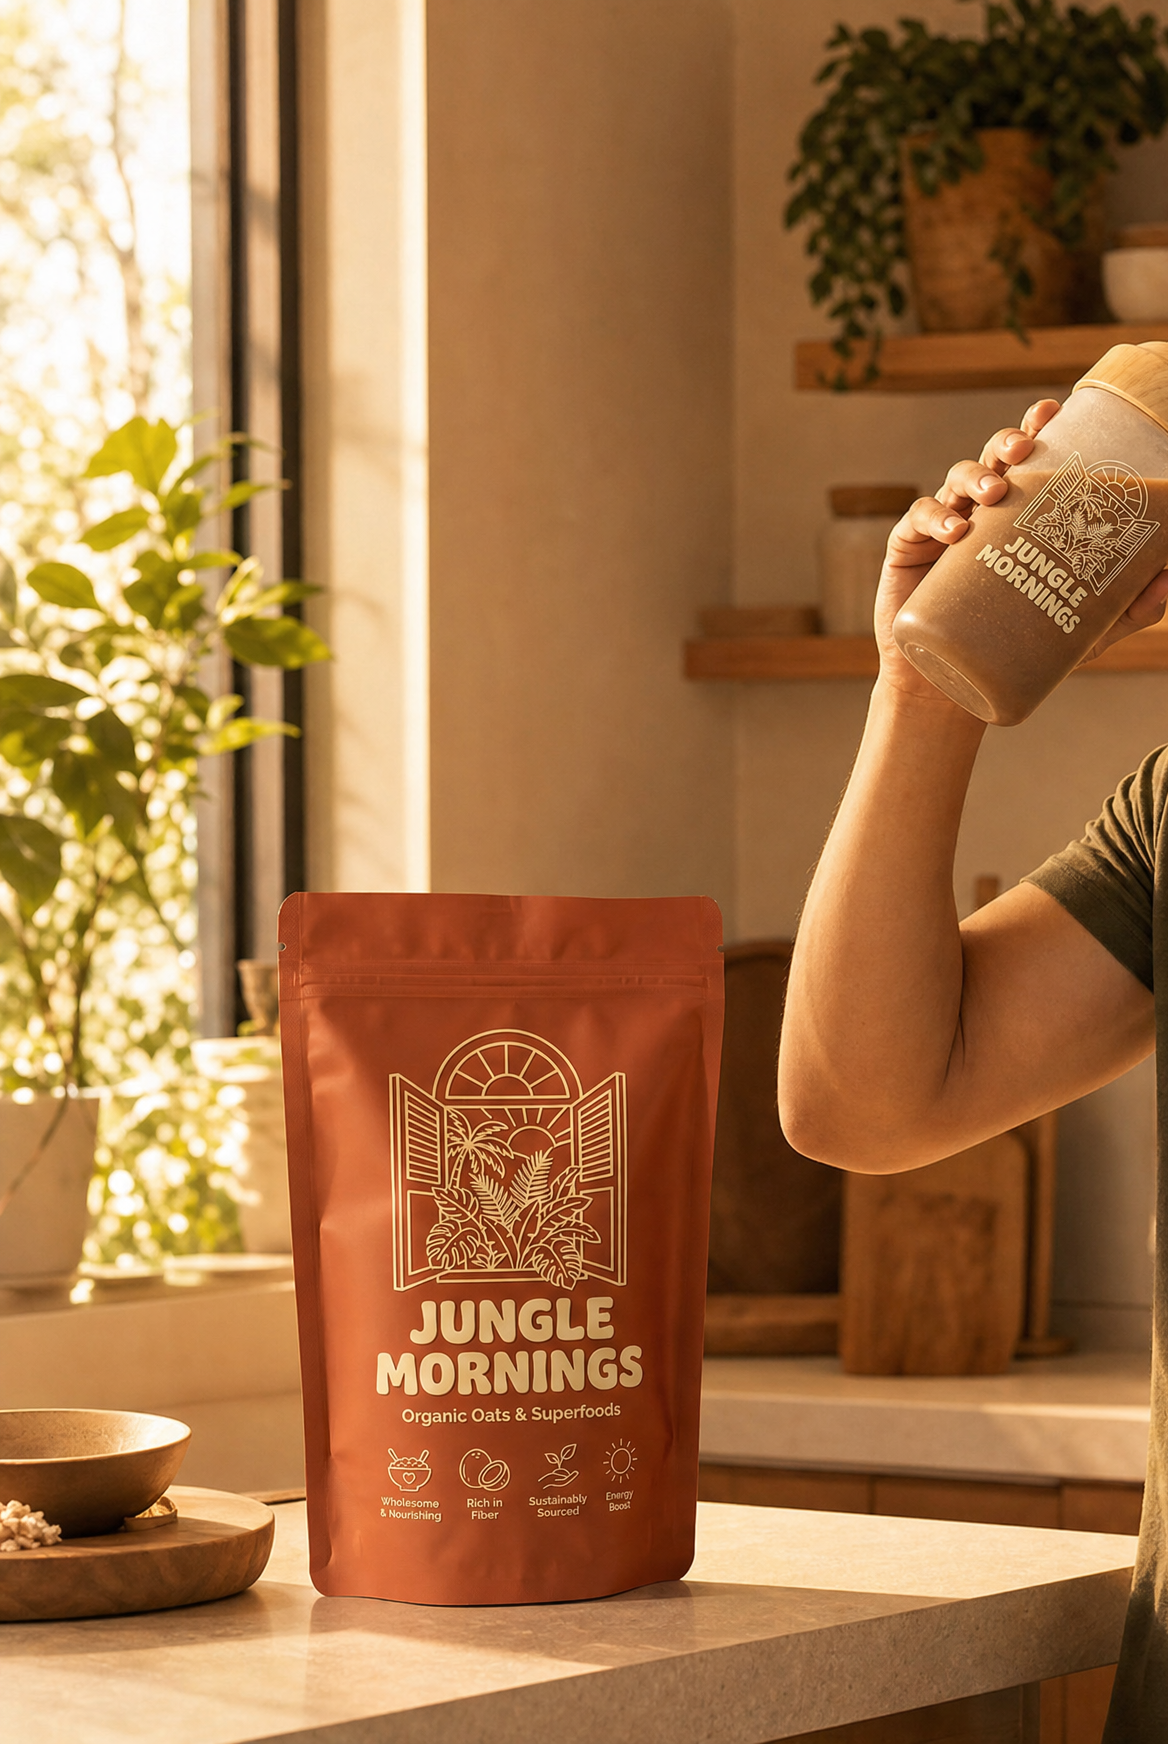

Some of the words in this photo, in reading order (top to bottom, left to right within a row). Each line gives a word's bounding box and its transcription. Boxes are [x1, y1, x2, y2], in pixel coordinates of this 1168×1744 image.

[1004, 536, 1089, 608] JUNGLE
[975, 544, 1080, 634] MORNINGS
[410, 1296, 615, 1345] JUNGLE
[376, 1345, 643, 1396] MORNINGS
[402, 1409, 467, 1427] Organic
[471, 1408, 510, 1422] Oats
[516, 1408, 527, 1421] &
[532, 1403, 621, 1423] Superfoods
[381, 1497, 439, 1508] Wholesome
[467, 1498, 490, 1508] Rich
[493, 1498, 502, 1507] in
[529, 1494, 587, 1506] Sustainably
[380, 1509, 386, 1517] &
[389, 1510, 442, 1522] Nourishing
[471, 1510, 499, 1520] Fiber
[537, 1506, 580, 1517] Sourced
